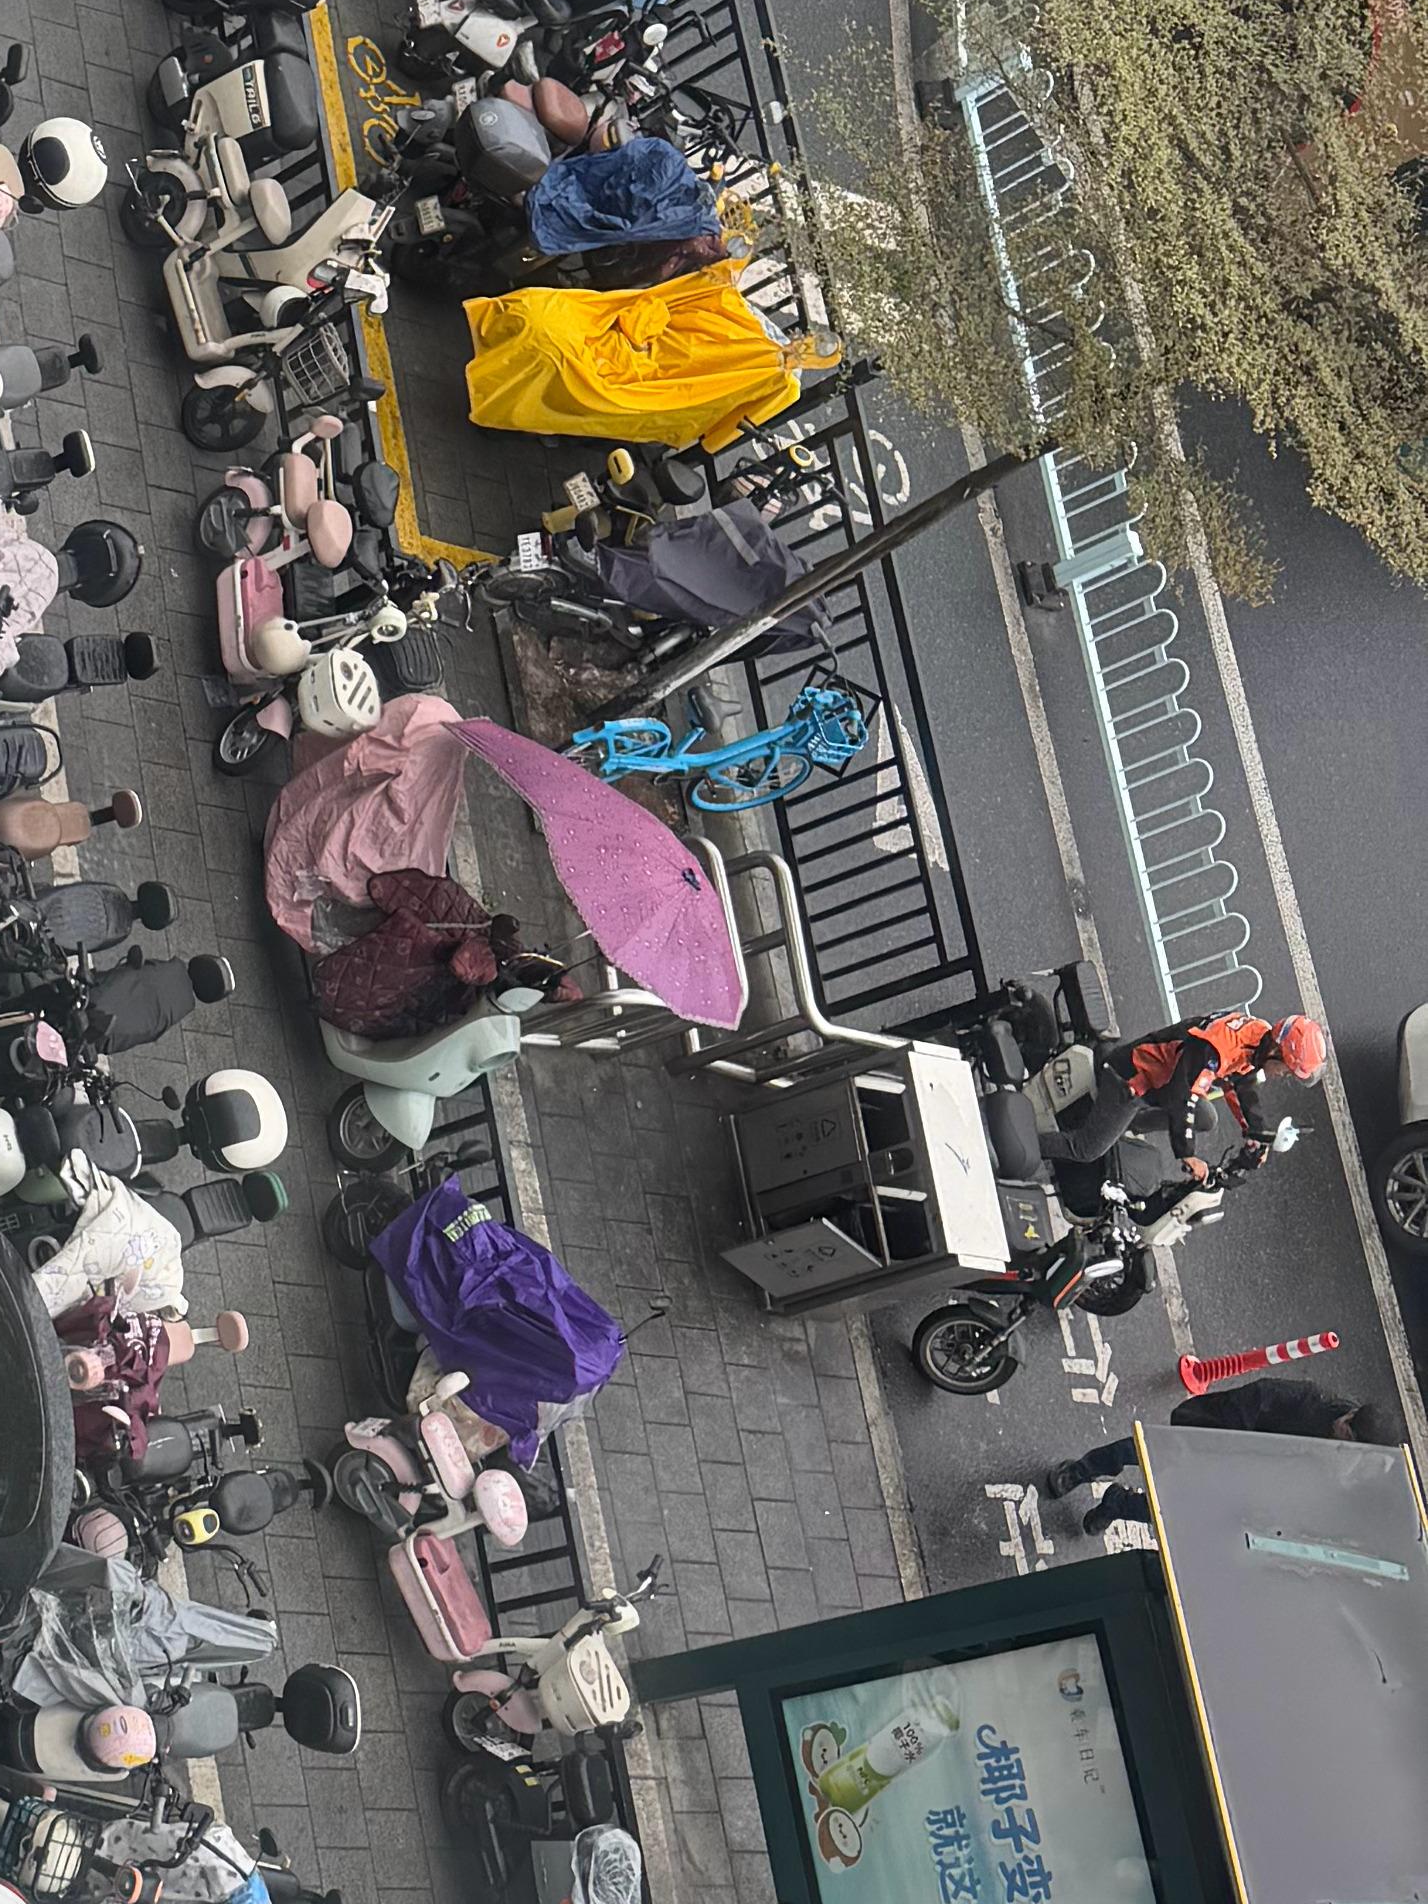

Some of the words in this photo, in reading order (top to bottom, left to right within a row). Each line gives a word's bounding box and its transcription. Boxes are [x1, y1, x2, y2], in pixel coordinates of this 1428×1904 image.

[890, 1725, 918, 1765] 椰子水
[901, 1721, 926, 1756] 100%
